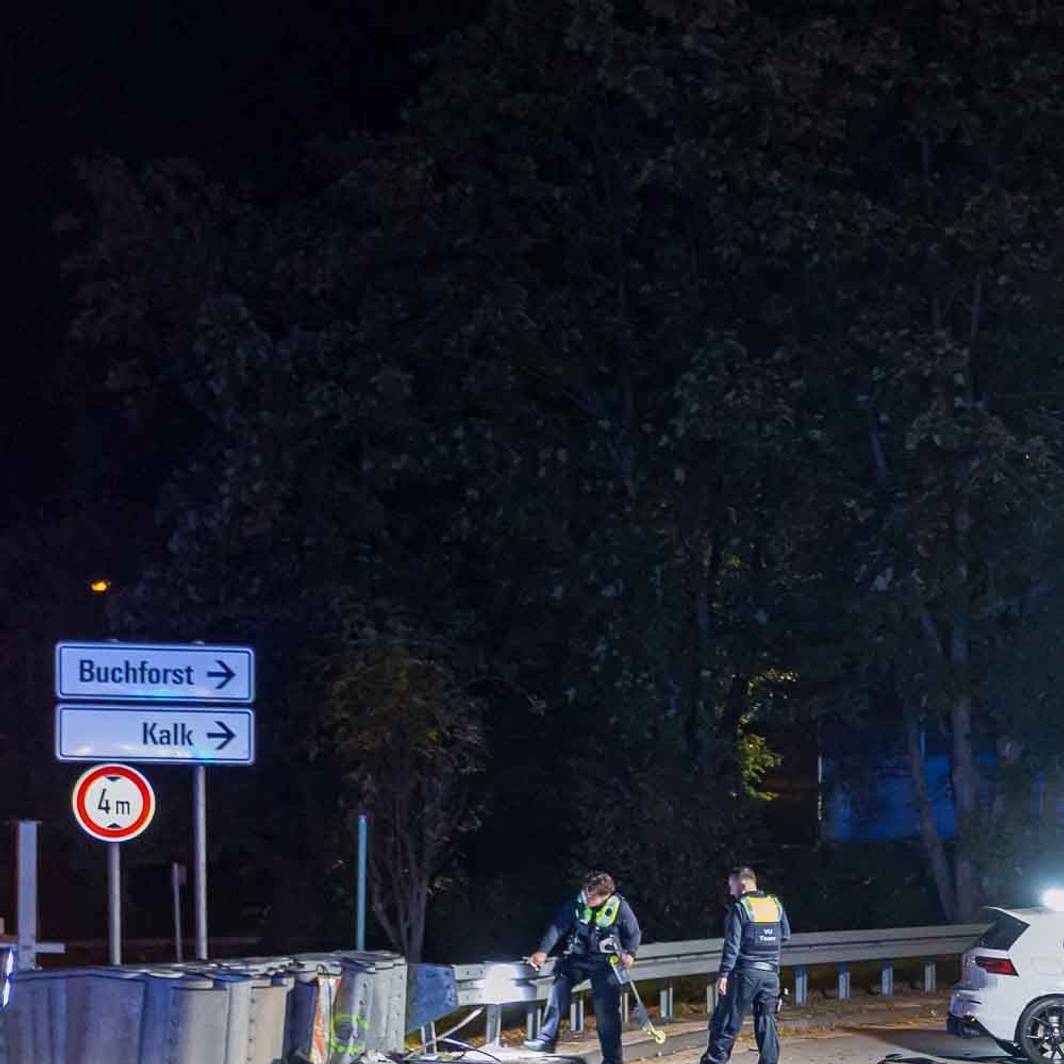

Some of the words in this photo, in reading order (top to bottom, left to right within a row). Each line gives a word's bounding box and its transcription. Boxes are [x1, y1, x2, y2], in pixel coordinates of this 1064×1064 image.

[79, 659, 195, 685] Buchforst
[142, 721, 194, 747] Kalk
[97, 788, 111, 814] 4
[115, 799, 131, 816] m
